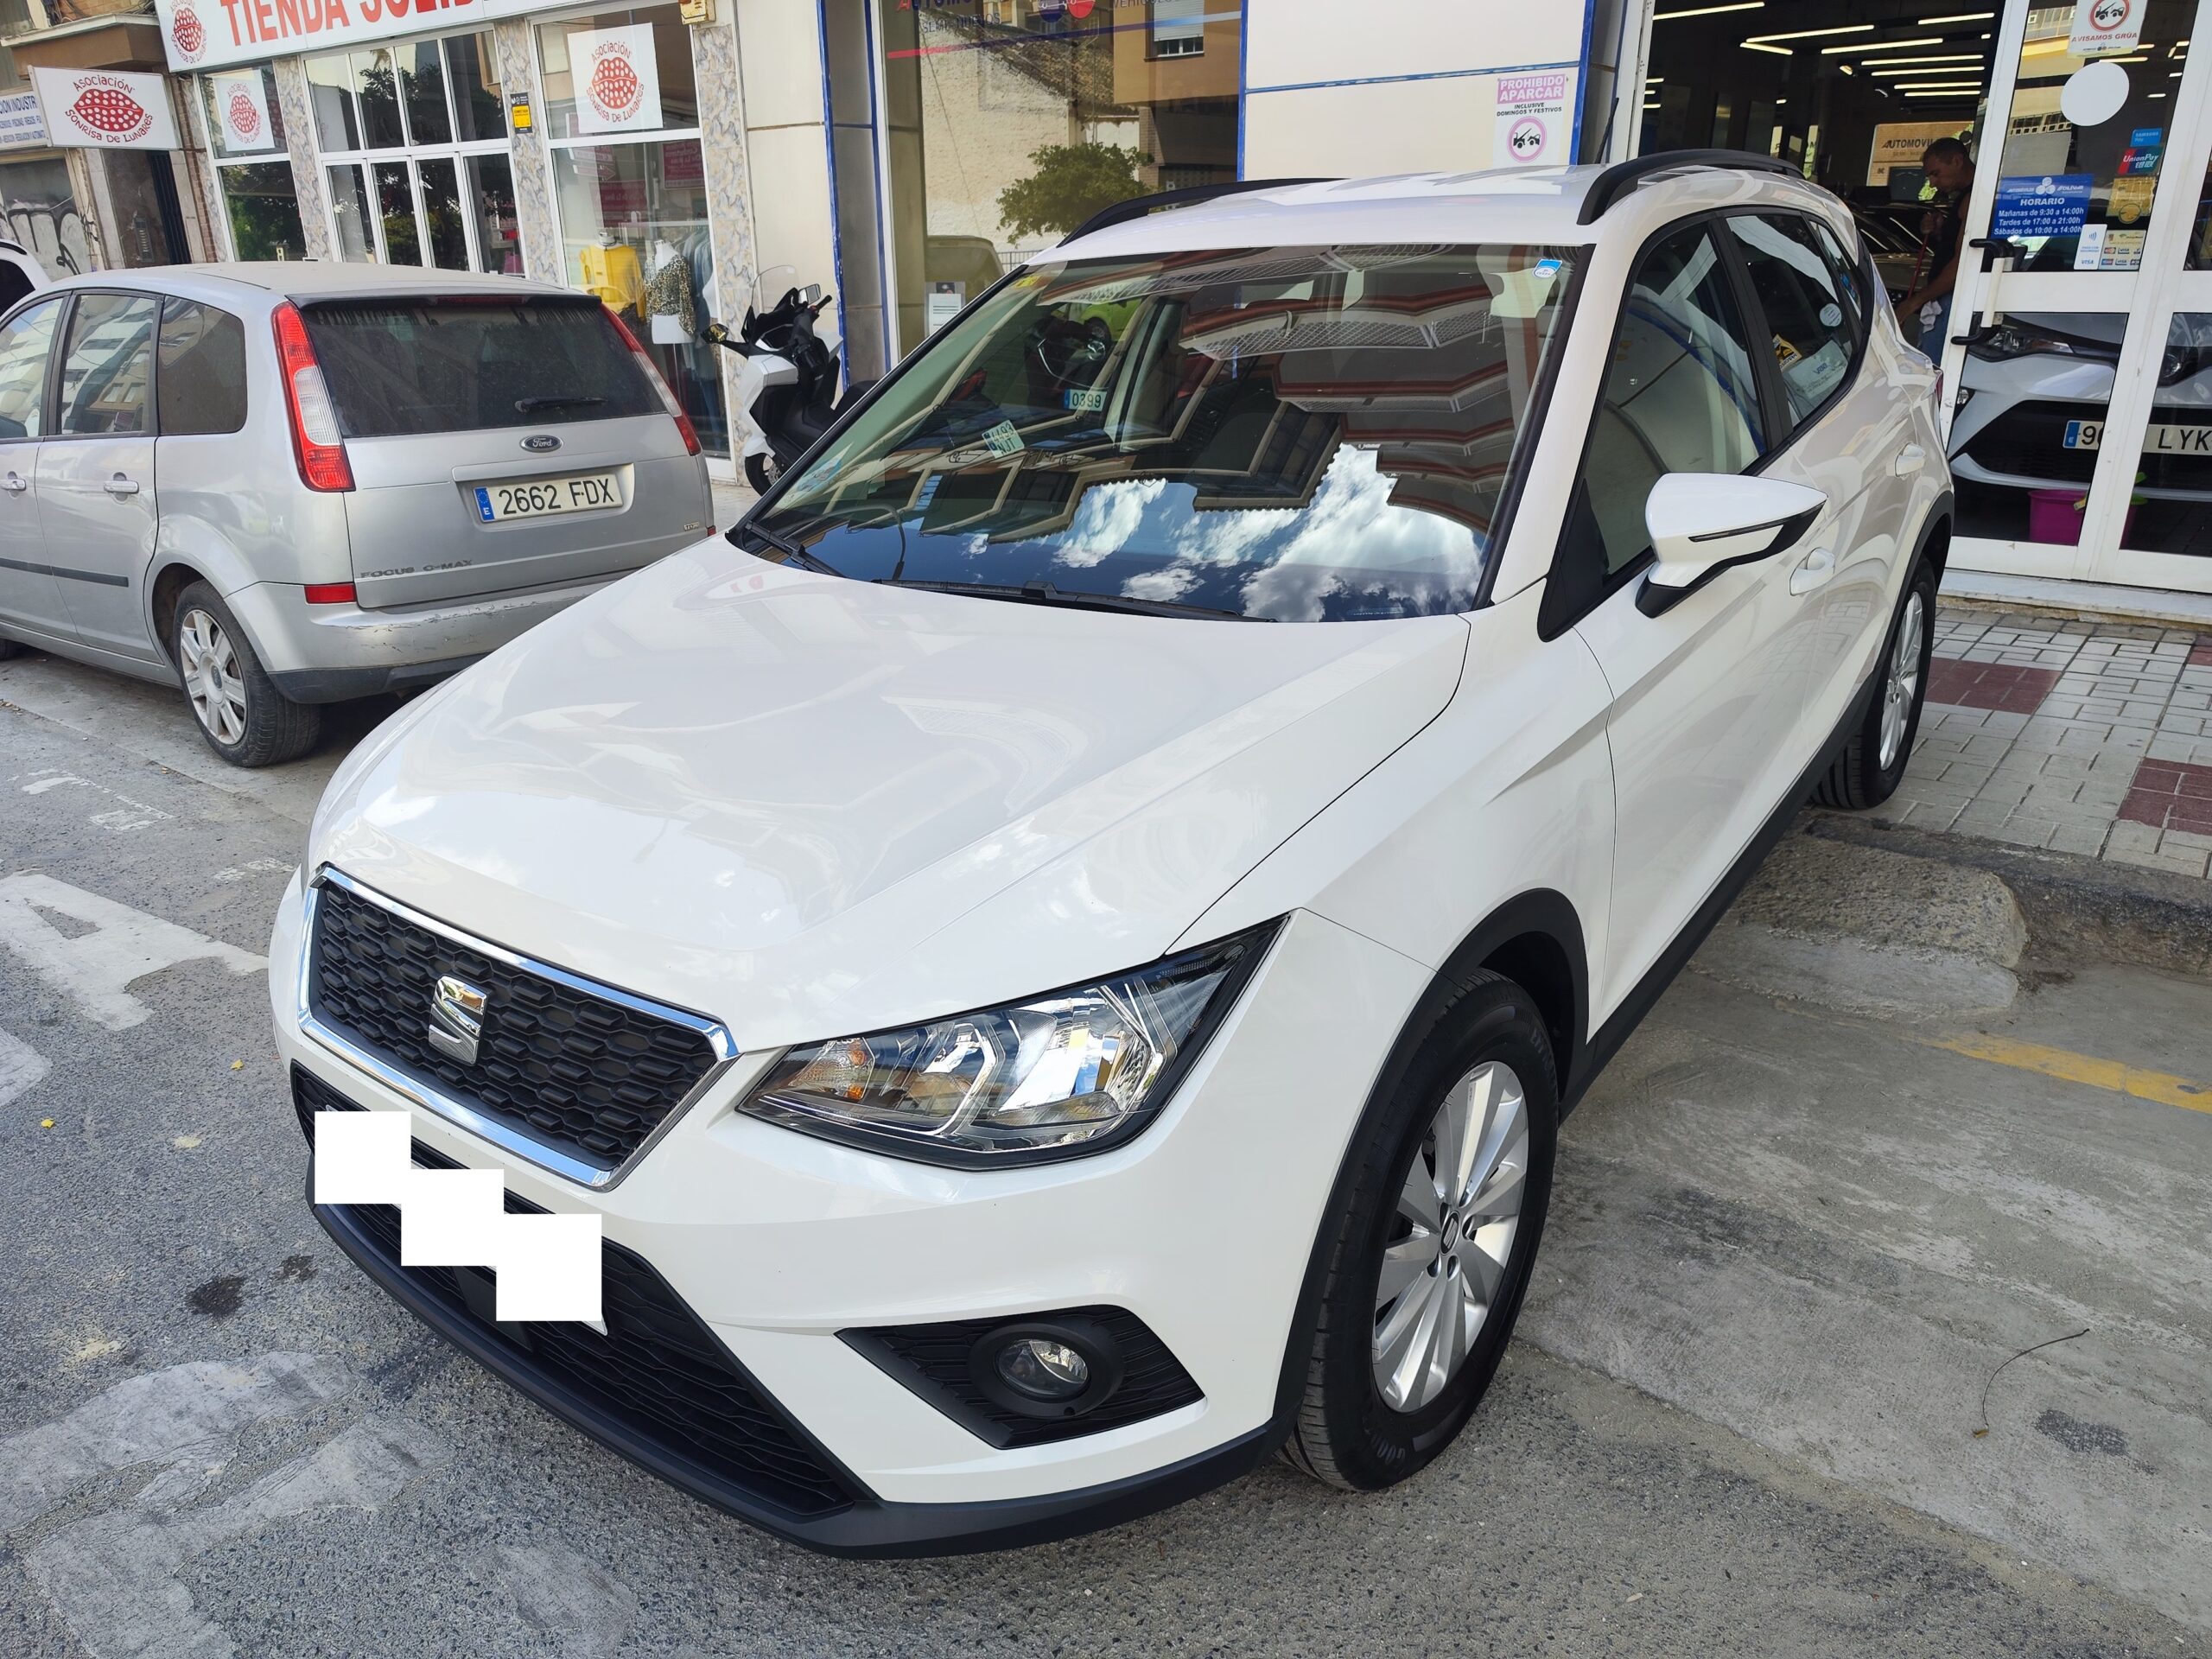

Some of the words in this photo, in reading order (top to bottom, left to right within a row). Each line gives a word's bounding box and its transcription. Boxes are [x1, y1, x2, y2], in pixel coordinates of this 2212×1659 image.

[2071, 34, 2113, 42] AVISAMOS
[1500, 75, 1564, 91] PROHIBIDO
[1499, 86, 1563, 102] APARCAR
[2123, 153, 2159, 162] UnionPay
[2020, 197, 2065, 207] HORARIO
[532, 437, 552, 448] Ford
[2158, 428, 2212, 451] LYK
[499, 484, 562, 515] 2662
[569, 479, 614, 506] FDX
[360, 567, 415, 578] FOCUS
[423, 559, 472, 571] C-MAX
